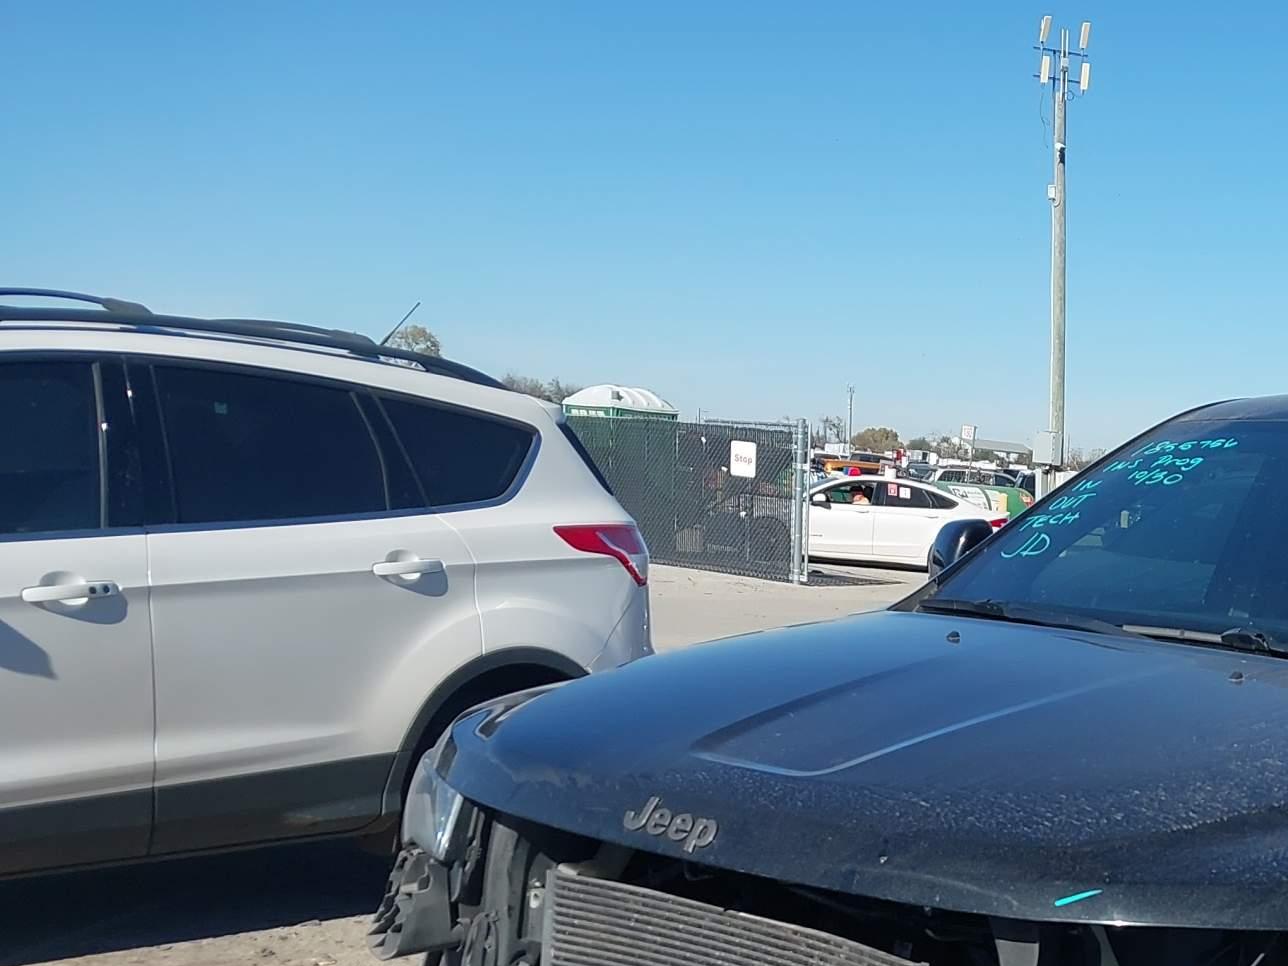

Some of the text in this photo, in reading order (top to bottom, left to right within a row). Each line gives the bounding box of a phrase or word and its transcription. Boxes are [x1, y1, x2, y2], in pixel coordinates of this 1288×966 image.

[734, 453, 753, 466] Stop
[1072, 479, 1102, 492] IN
[1127, 468, 1183, 486] 10/30
[1048, 493, 1097, 511] OUT
[1019, 513, 1081, 532] TECH
[1000, 532, 1051, 559] JD
[623, 796, 720, 854] Jeep
